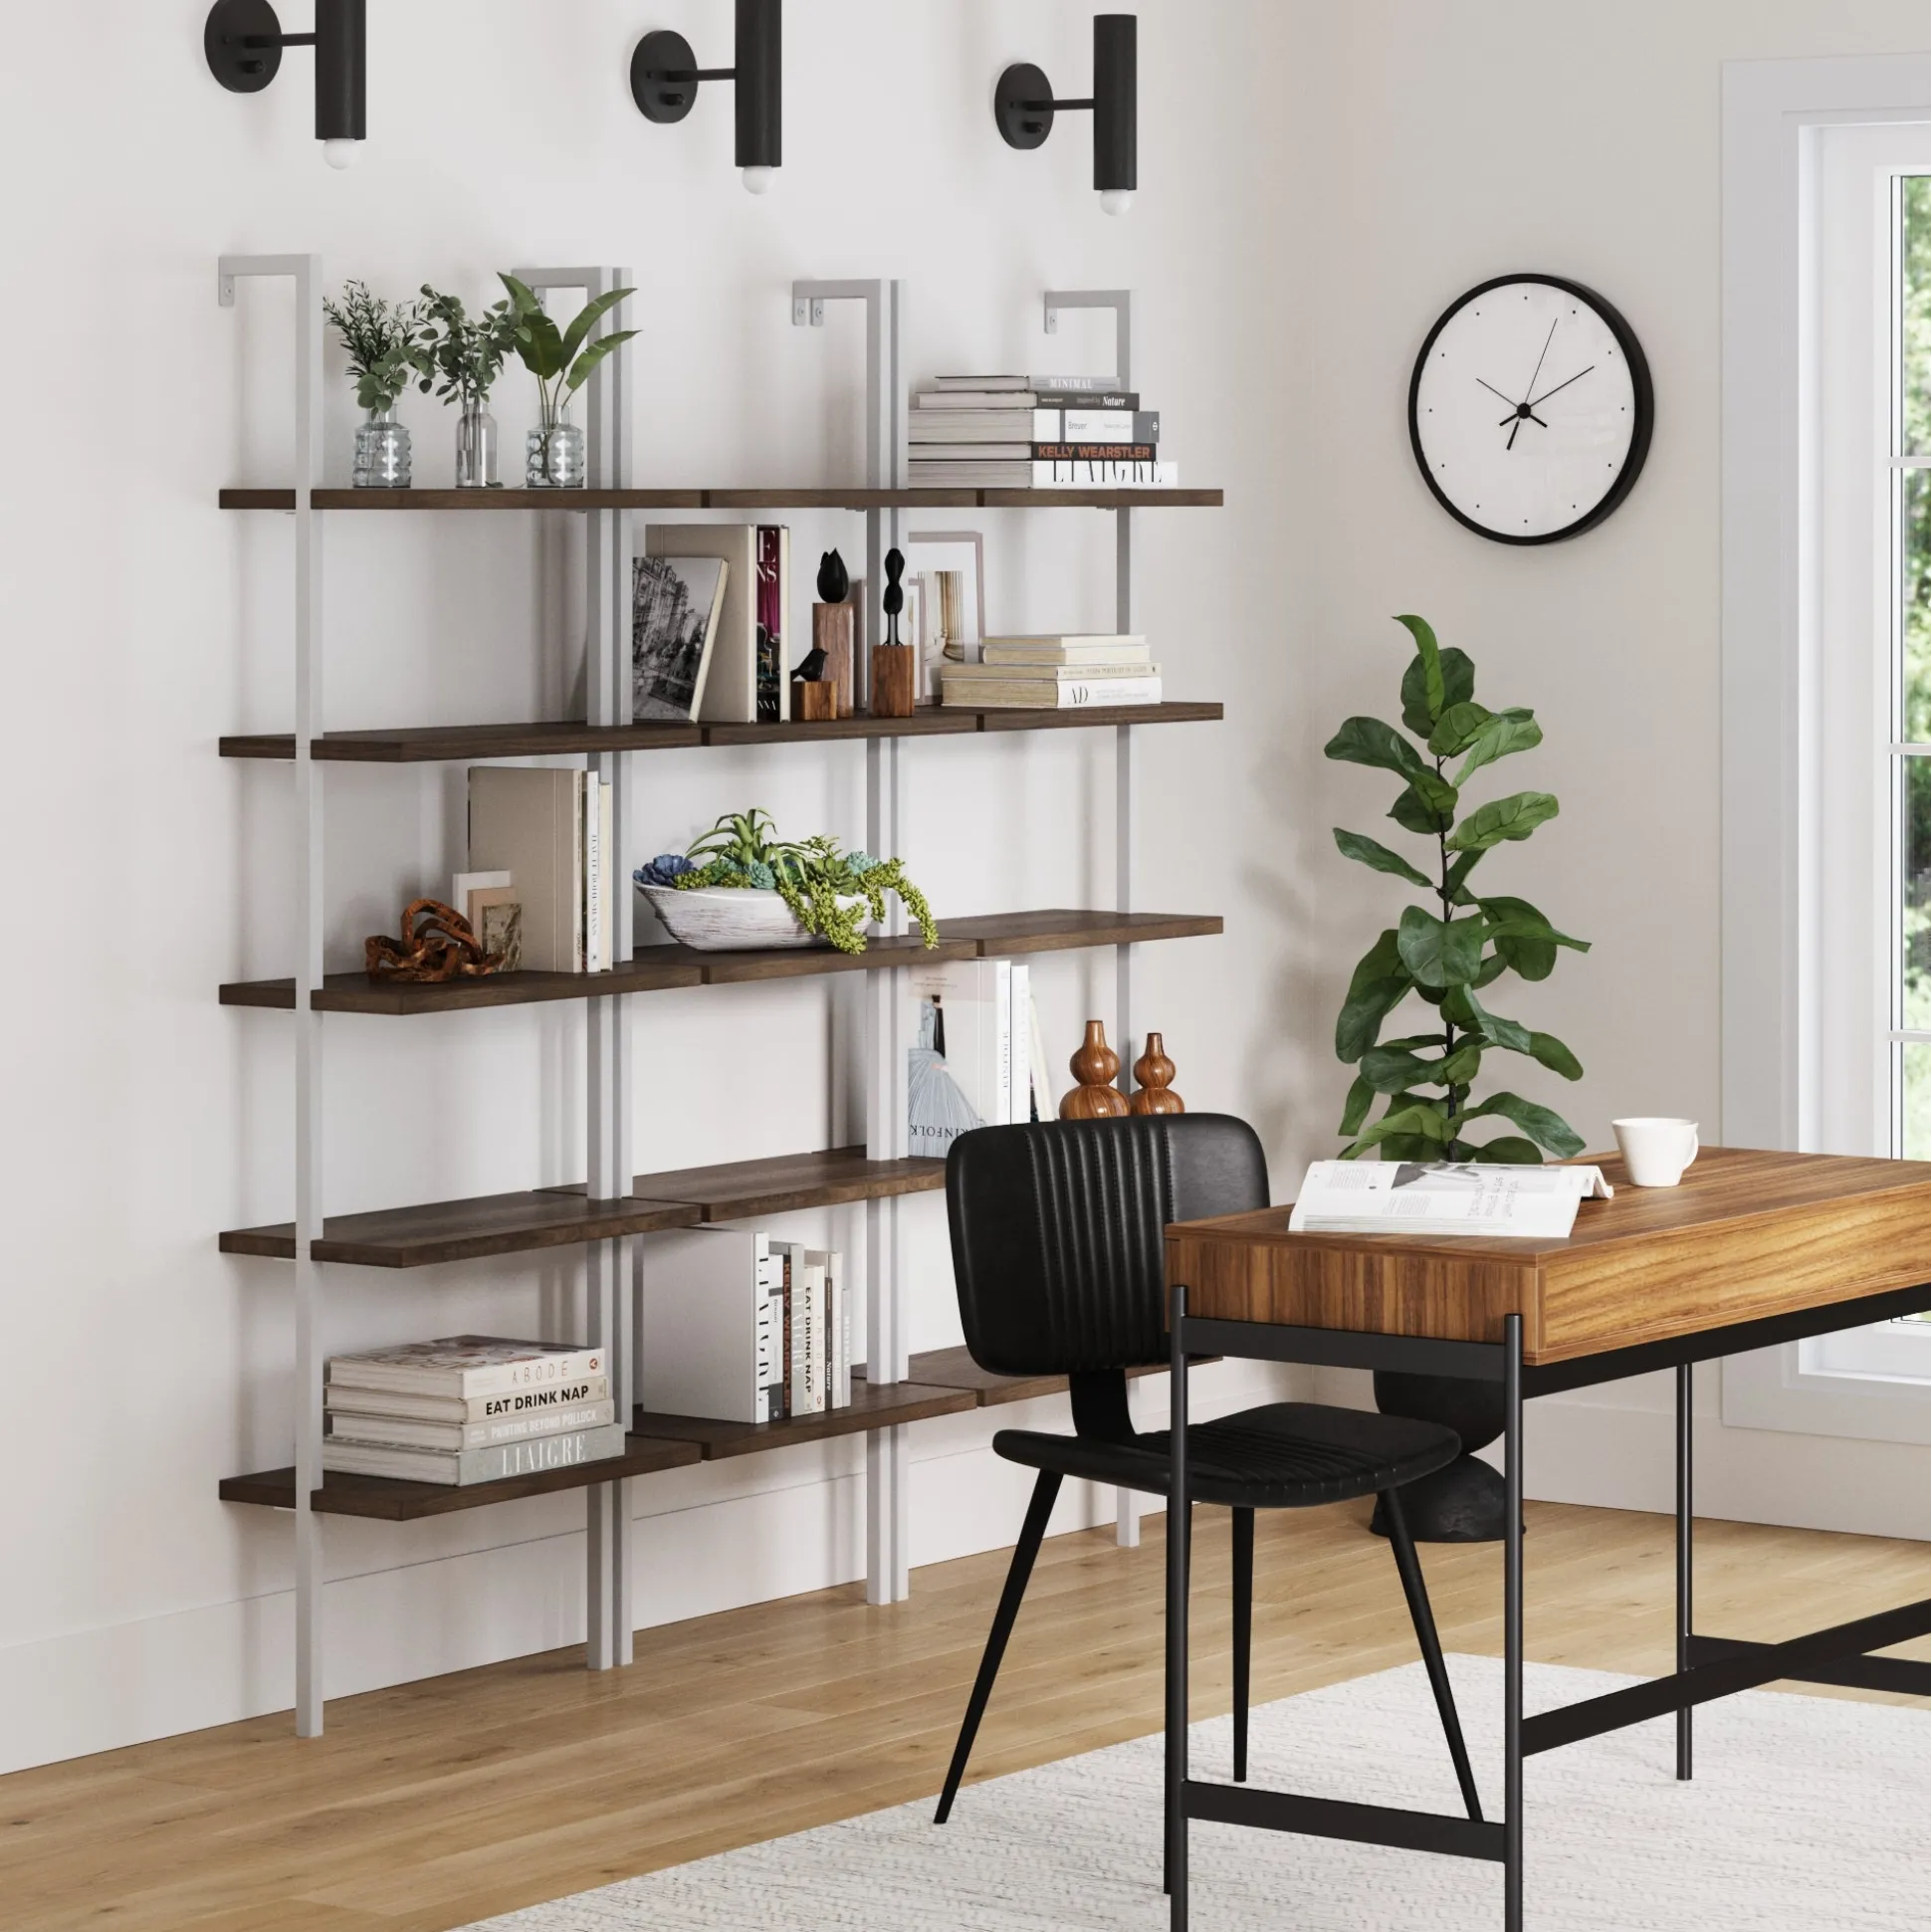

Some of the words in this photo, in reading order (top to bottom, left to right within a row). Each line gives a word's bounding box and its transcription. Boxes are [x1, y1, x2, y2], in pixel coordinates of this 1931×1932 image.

[1049, 378, 1092, 389] MINIMAL
[1102, 395, 1126, 407] Nature
[1038, 446, 1074, 458] KELLY
[1078, 446, 1150, 458] WEARSTLER
[512, 1361, 568, 1385] ABODE
[486, 1398, 511, 1415] EAT
[515, 1391, 557, 1409] DRINK
[560, 1385, 589, 1401] NAP
[491, 1422, 529, 1439] PAINTING
[529, 1415, 561, 1433] BEYOND
[561, 1408, 597, 1426] POLLOCK
[502, 1433, 585, 1475] LIAIGRE
